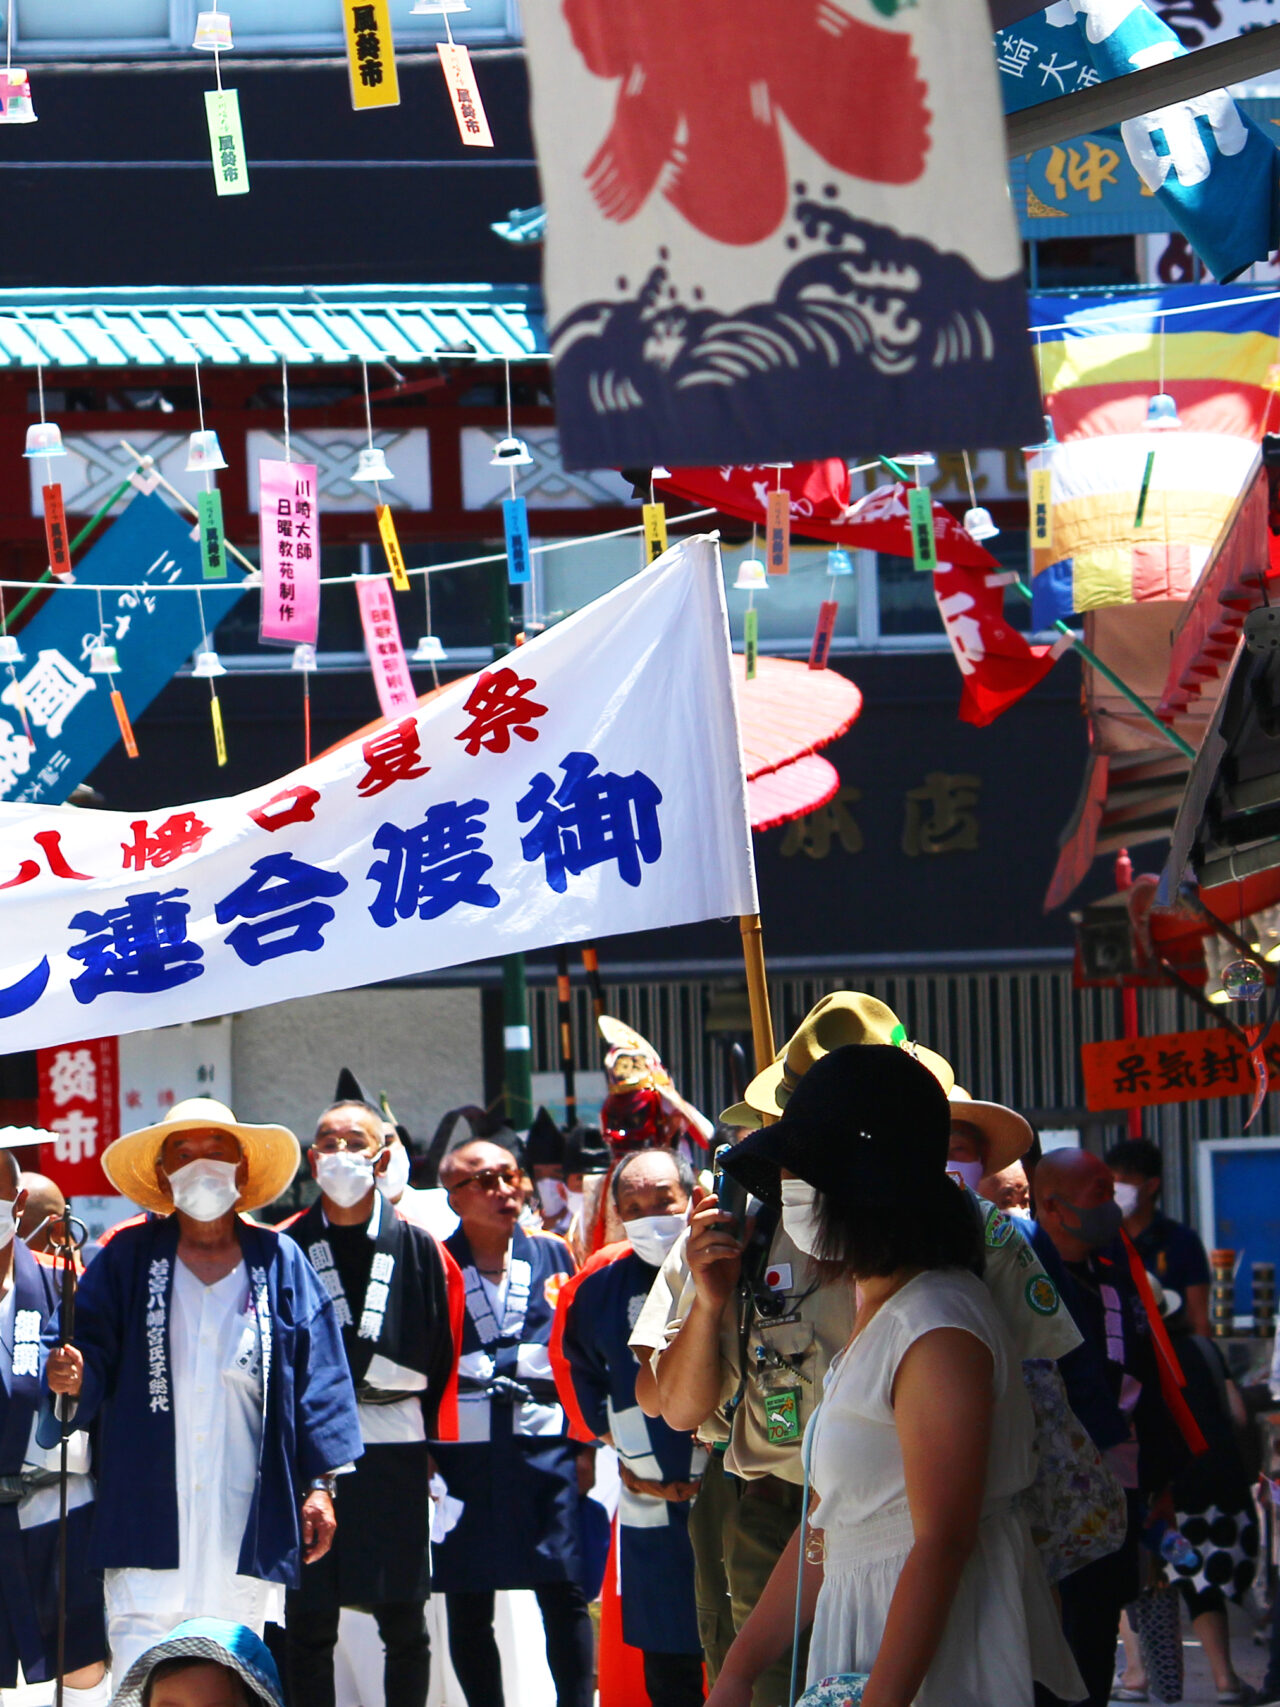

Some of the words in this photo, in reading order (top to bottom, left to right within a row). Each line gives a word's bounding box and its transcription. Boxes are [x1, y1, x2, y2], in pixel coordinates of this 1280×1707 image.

[352, 4, 383, 88] 風鈴市
[456, 88, 480, 134] 風鈴市
[218, 135, 238, 182] 風鈴市
[1045, 141, 1154, 202] 仲
[295, 480, 312, 560] 川崎大師
[277, 498, 295, 622] 日曜教苑制作
